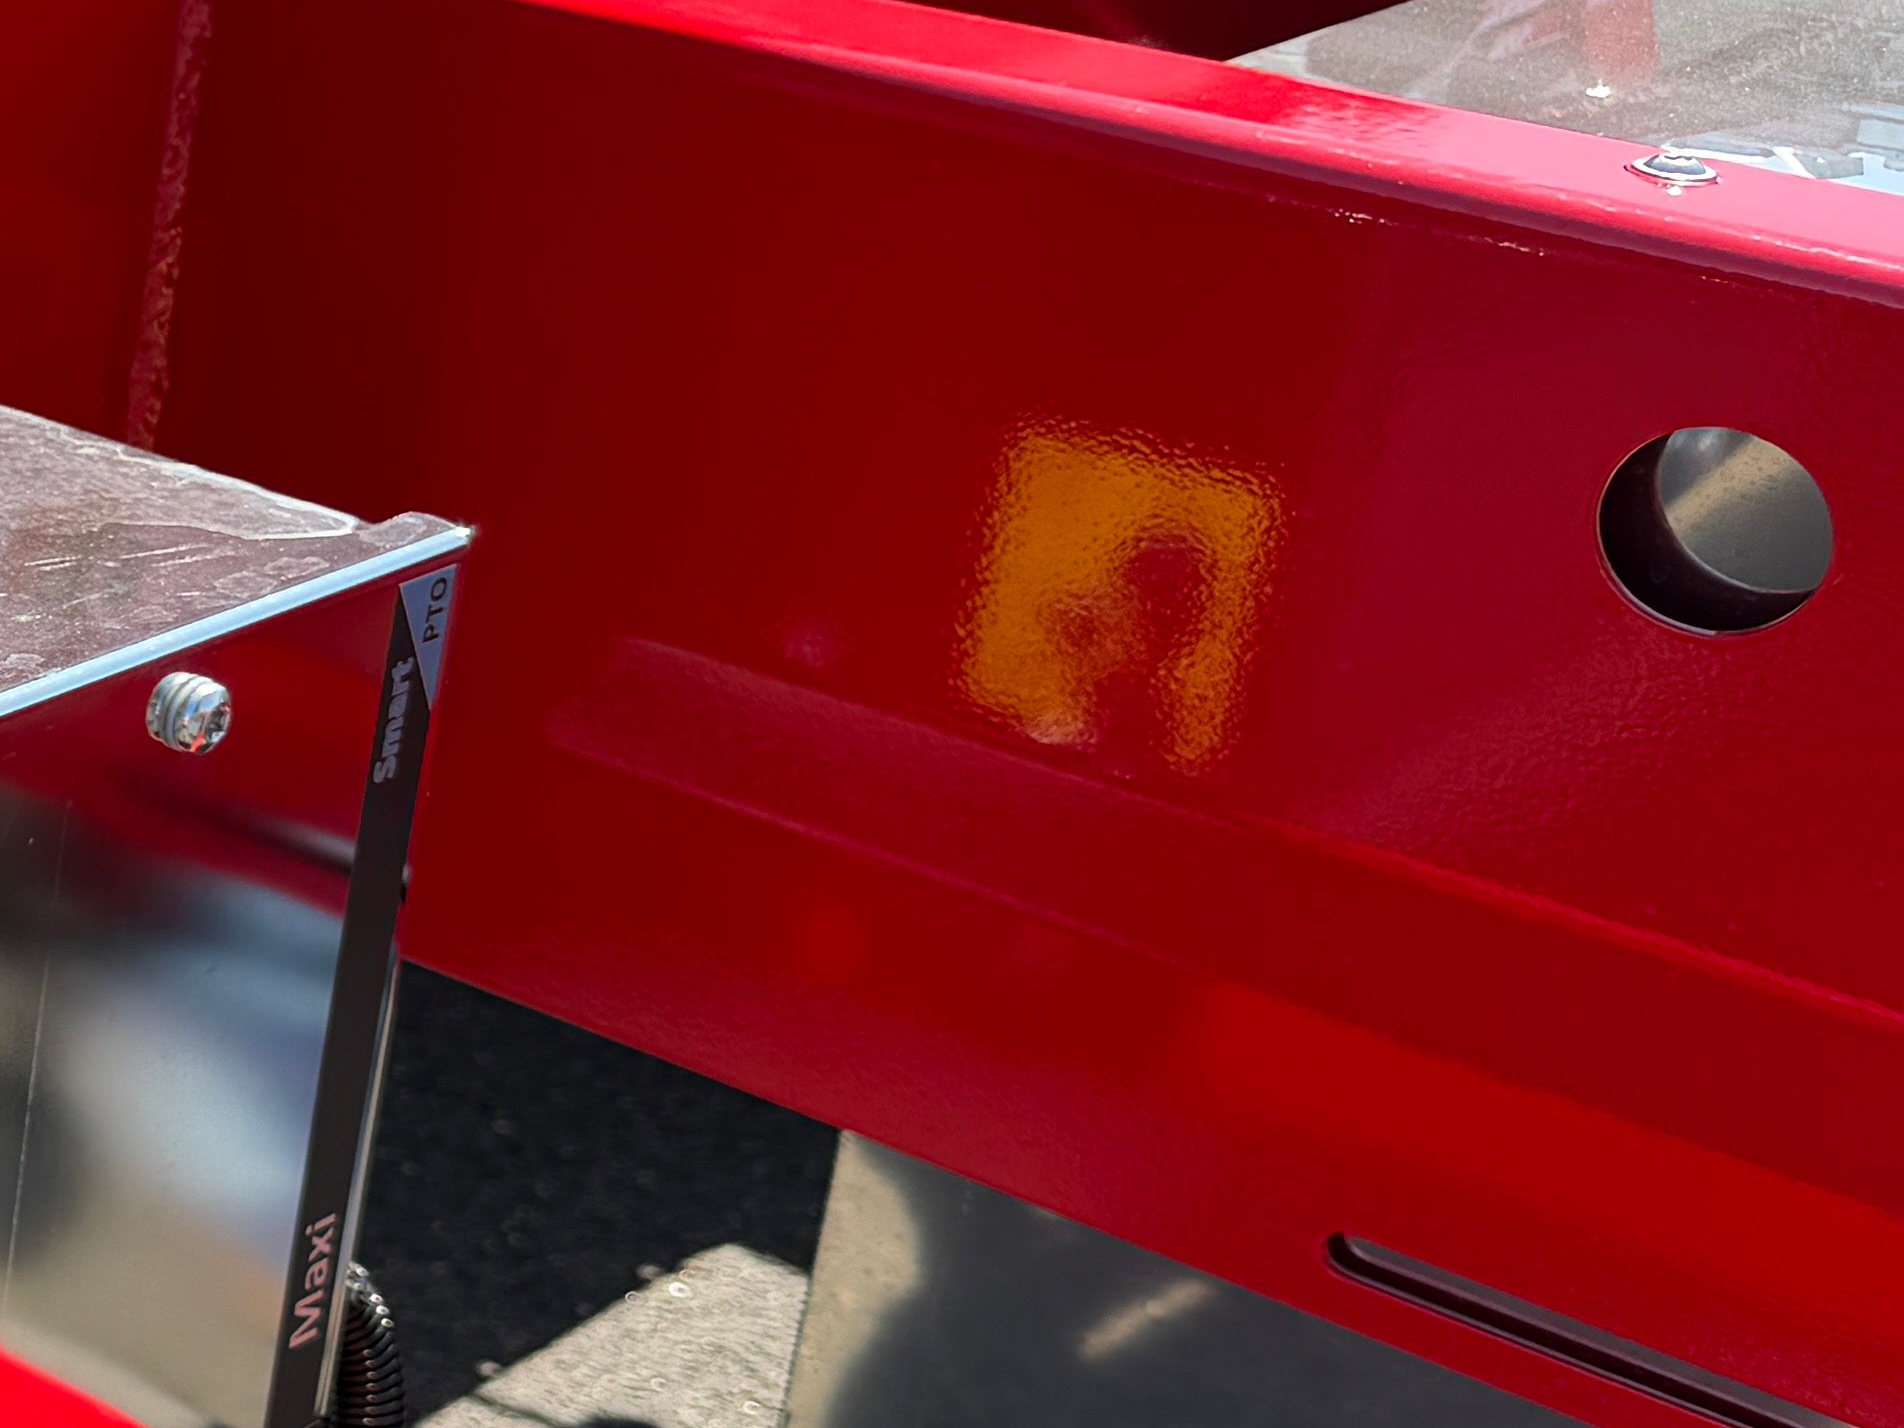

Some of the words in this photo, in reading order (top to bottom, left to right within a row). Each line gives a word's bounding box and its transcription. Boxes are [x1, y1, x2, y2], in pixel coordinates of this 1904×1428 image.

[422, 576, 449, 644] PTO
[373, 656, 415, 784] Smart
[289, 1212, 337, 1350] Maxi
